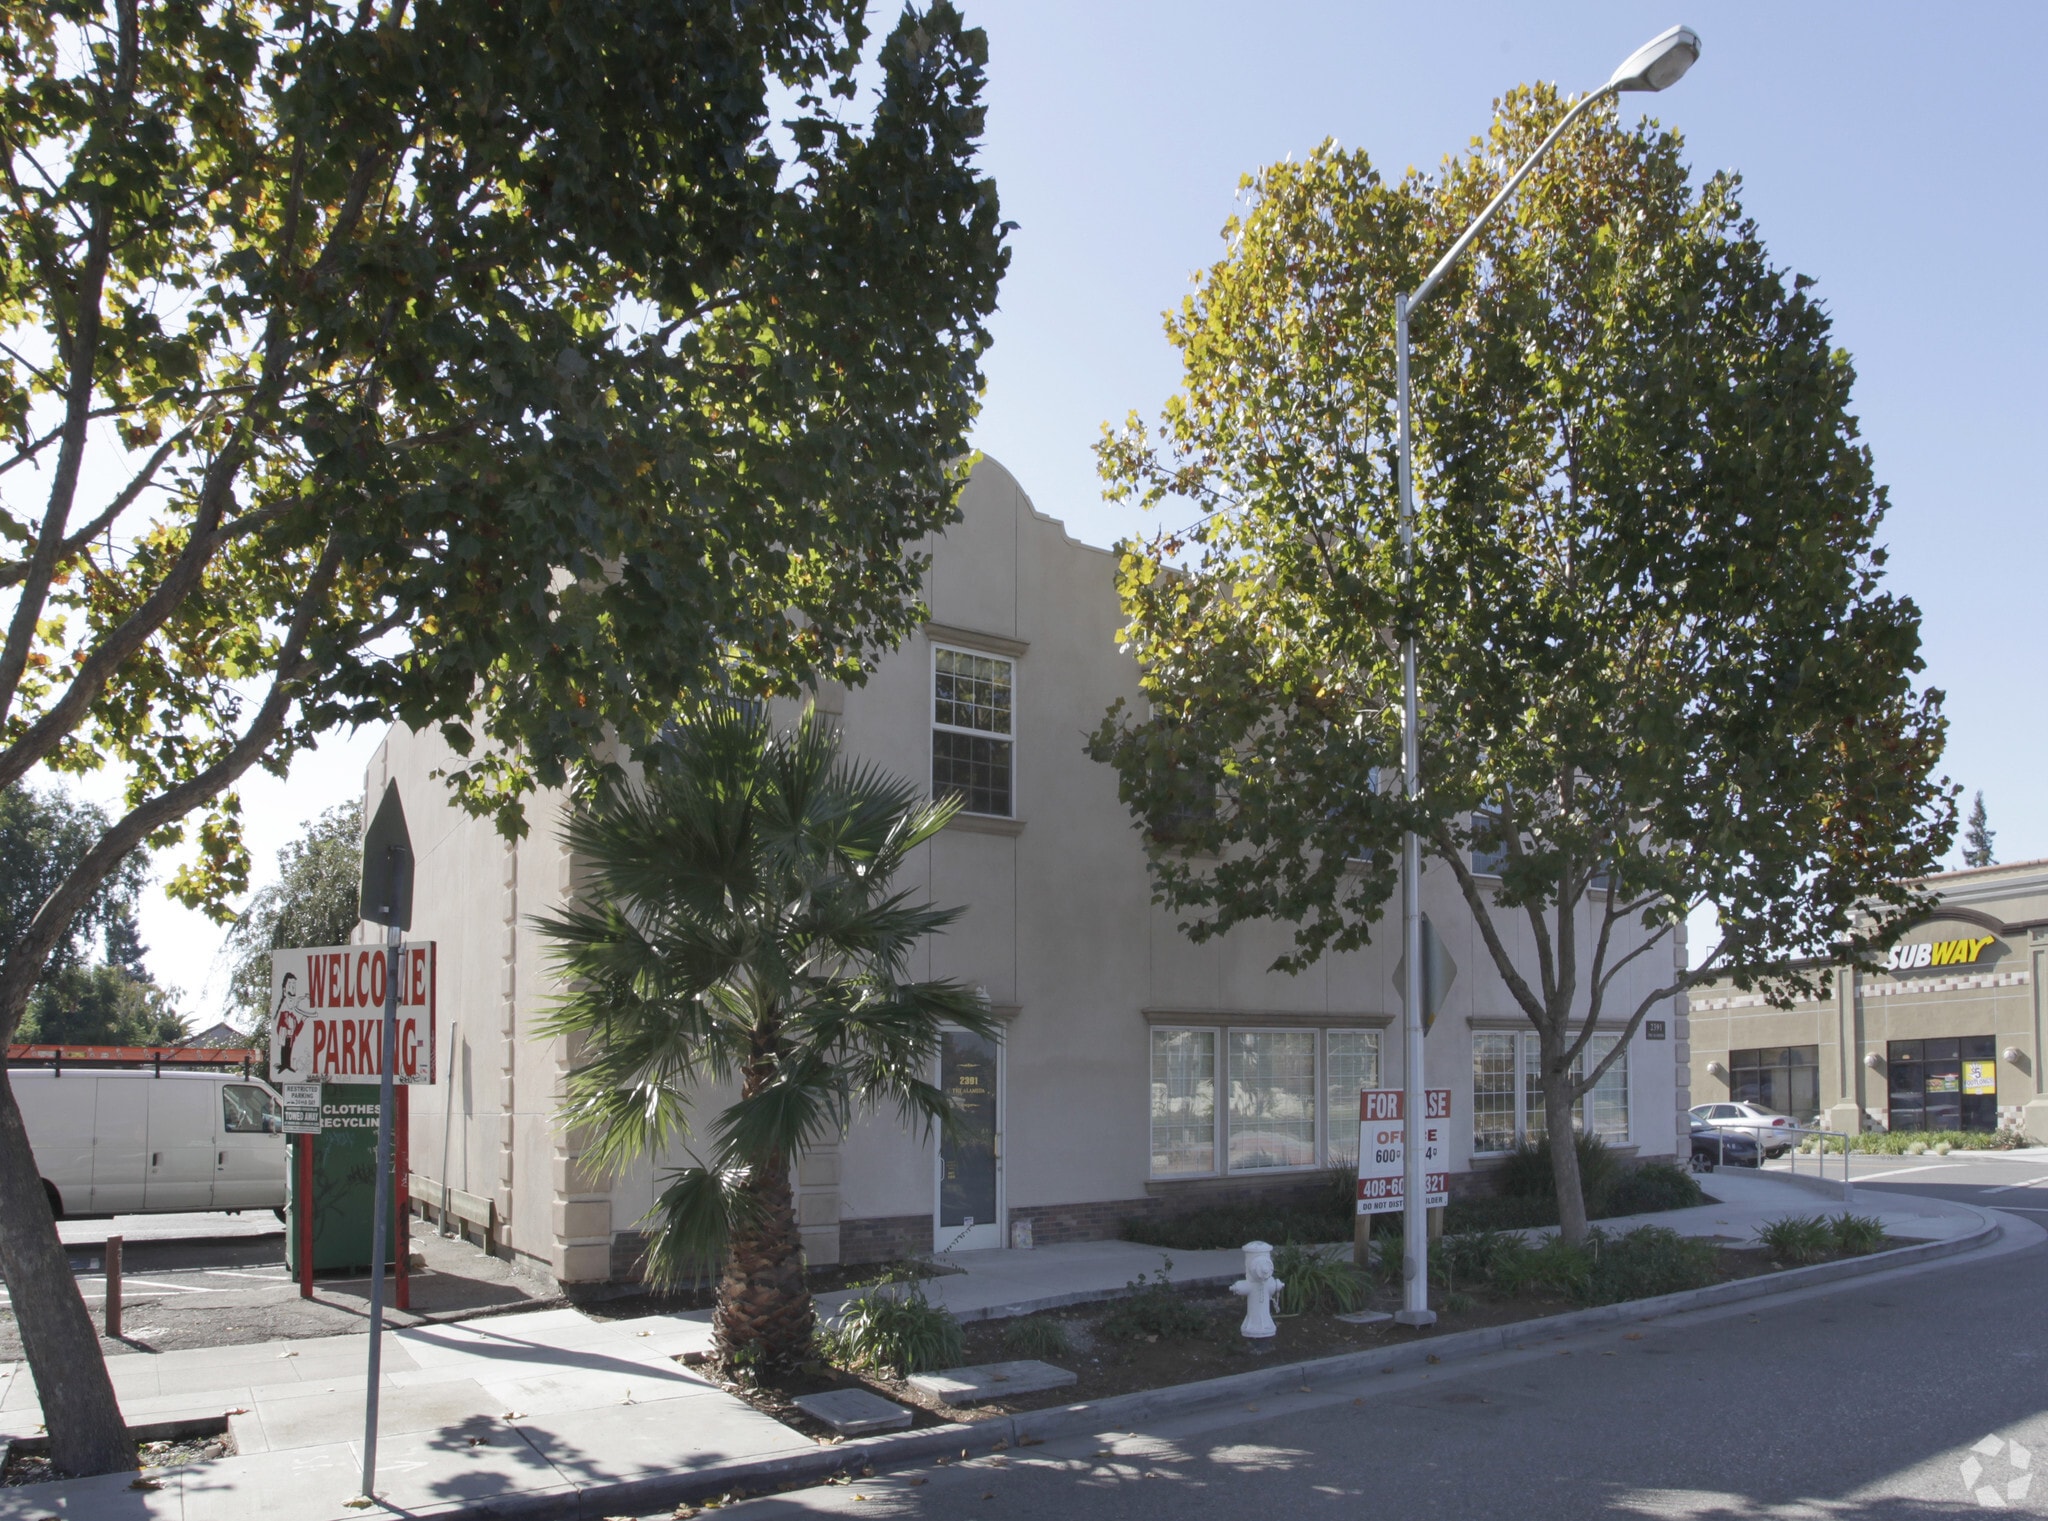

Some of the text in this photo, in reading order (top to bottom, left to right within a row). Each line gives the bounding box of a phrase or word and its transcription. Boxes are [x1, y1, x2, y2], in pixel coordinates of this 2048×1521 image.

[1882, 935, 1995, 971] SUBWAY
[960, 1076, 978, 1085] 2391
[323, 1104, 380, 1114] CLOTHES
[1367, 1093, 1397, 1118] FOR
[285, 1111, 319, 1121] TOWED AWAY
[320, 1117, 380, 1128] RECYCLIN
[1376, 1129, 1438, 1145] OFE
[1362, 1203, 1372, 1211] DO
[1373, 1201, 1387, 1210] NOT
